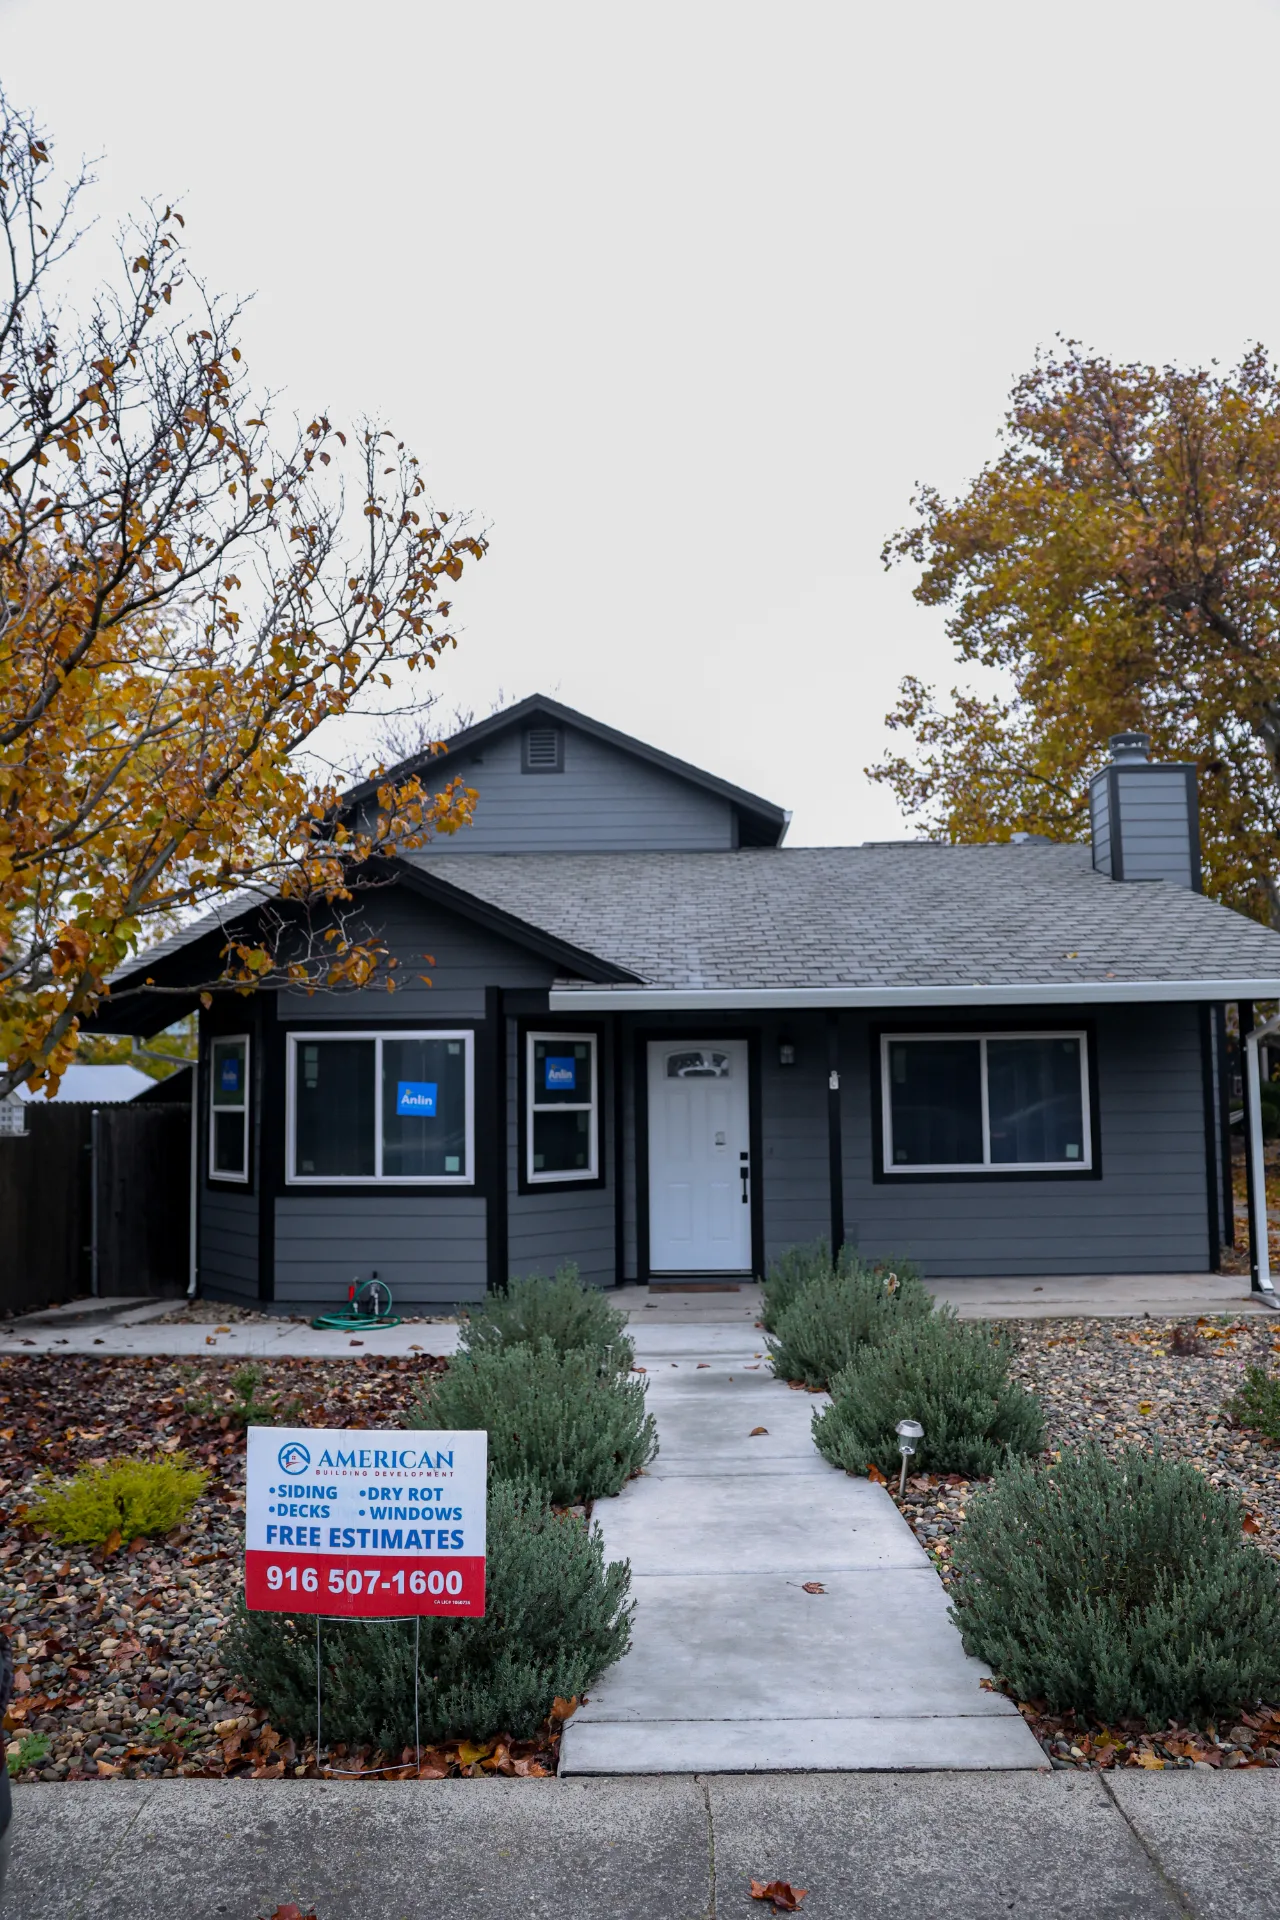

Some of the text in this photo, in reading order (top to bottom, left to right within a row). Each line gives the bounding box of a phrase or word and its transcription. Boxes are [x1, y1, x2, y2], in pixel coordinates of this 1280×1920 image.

[401, 1094, 433, 1106] Anlin
[318, 1449, 454, 1469] AMERICAN
[278, 1484, 338, 1500] SIDING
[368, 1486, 444, 1502] DRY ROT
[277, 1503, 330, 1519] DECKS
[370, 1506, 463, 1521] WINDOWS
[266, 1524, 465, 1550] FREE ESTIMATES
[266, 1565, 463, 1595] 916 507-1600
